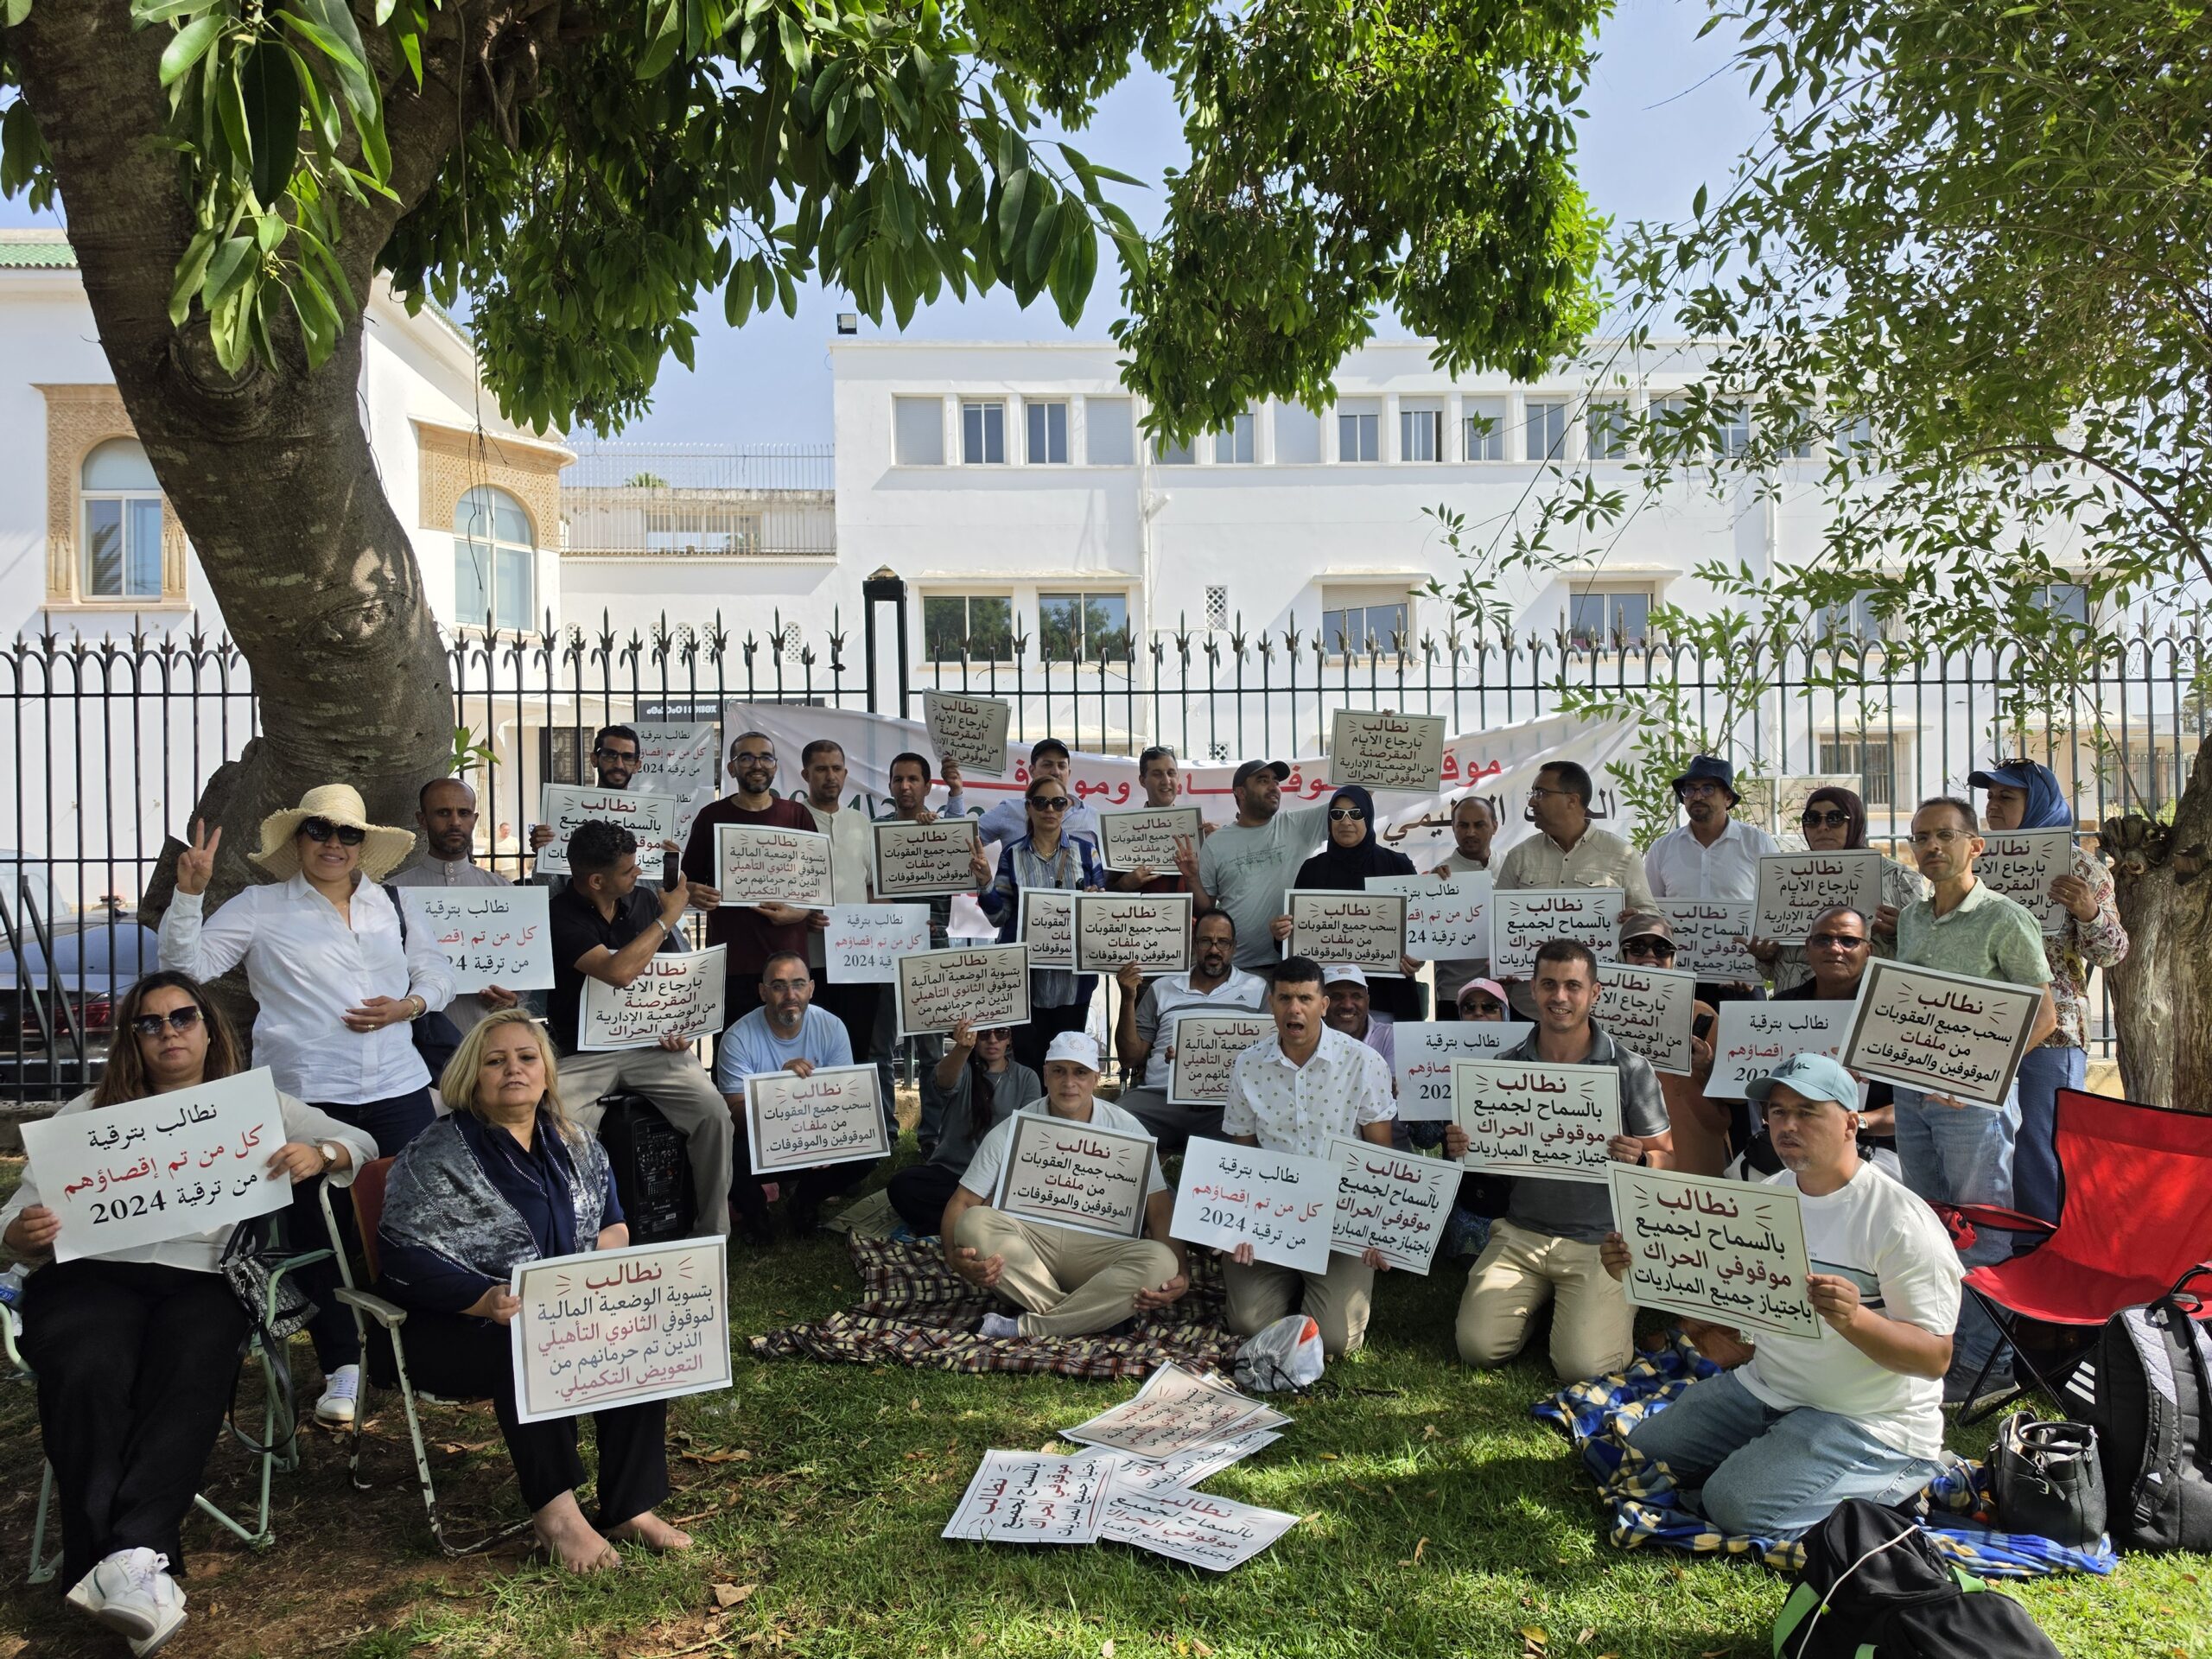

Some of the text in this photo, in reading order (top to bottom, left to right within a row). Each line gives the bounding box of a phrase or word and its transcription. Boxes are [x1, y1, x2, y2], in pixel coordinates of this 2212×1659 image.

[1362, 718, 1409, 734] نطالب
[1347, 769, 1426, 785] لموقوفي الحراك
[1375, 760, 1420, 774] الوضعية
[1421, 765, 1434, 774] من
[1790, 860, 1844, 880] نطالب
[425, 899, 509, 920] نطالب بترقية
[1111, 906, 1157, 922] نطالب
[1526, 897, 1583, 917] نطالب
[1084, 923, 1181, 938] بسحب جميع العقوبات
[1507, 916, 1611, 934] بالسماح لجميع
[471, 925, 537, 949] كل من تم
[1108, 937, 1158, 950] من ملفات
[474, 955, 529, 975] من ترقية
[939, 954, 988, 972] نطالب
[1141, 950, 1181, 963] الموقوفين
[911, 968, 1020, 987] بتسوية الوضعية المالية
[987, 979, 1021, 995] لموقوفي
[646, 1004, 700, 1023] الوضعية
[702, 1002, 716, 1014] من
[918, 992, 1013, 1016] الذين تم حرمانهم من
[971, 1004, 1013, 1021] التعويض
[1917, 991, 1983, 1015] نطالب
[608, 1014, 707, 1037] لموقوفي الحراك
[1749, 1014, 1829, 1035] نطالب بترقية
[1874, 1004, 2012, 1047] بسحب جميع العقوبات
[1426, 1033, 1500, 1052] نطالب بترقية
[1900, 1031, 1971, 1058] من ملفات
[1939, 1061, 2001, 1083] الموقوفين
[791, 1082, 842, 1103] نطالب
[1496, 1072, 1567, 1096] نطالب
[764, 1102, 872, 1122] بسحب جميع العقوبات
[1473, 1097, 1603, 1122] بالسماح لجميع
[87, 1104, 217, 1151] نطالب بترقية
[791, 1119, 847, 1134] من ملفات
[830, 1128, 876, 1147] الموقوفين
[1477, 1119, 1605, 1147] موقوفي الحراك
[235, 1123, 264, 1159] كل
[1056, 1139, 1111, 1160] نطالب
[199, 1146, 225, 1168] من
[1466, 1141, 1572, 1164] جميع المباريات
[168, 1151, 188, 1179] تم
[1020, 1152, 1138, 1187] بسحب جميع العقوبات
[1218, 1157, 1300, 1185] نطالب بترقية
[1365, 1160, 1422, 1184] نطالب
[1045, 1174, 1105, 1197] من ملفات
[1338, 1176, 1440, 1214] بالسماح لجميع
[90, 1173, 257, 1224] من ترقية 2024
[1081, 1199, 1132, 1218] الموقوفين
[1255, 1198, 1271, 1214] تم
[1656, 1187, 1739, 1218] نطالب
[1274, 1204, 1294, 1217] من
[1298, 1202, 1324, 1223] كل
[1336, 1197, 1431, 1234] موقوفي الحراك
[1199, 1206, 1306, 1250] من ترقية 2024
[1636, 1217, 1785, 1261] بالسماح لجميع
[1368, 1231, 1431, 1258] باجتياز جميع
[1643, 1241, 1792, 1291] موقوفي الحراك
[585, 1261, 662, 1295] نطالب
[537, 1285, 712, 1320] بتسوية الوضعية المالية
[1634, 1268, 1812, 1324] باجتياز جميع المباريات
[605, 1313, 658, 1346] الثانوي
[662, 1305, 715, 1337] لموقوفي
[550, 1331, 702, 1376] الذين تم حرمانهم من
[635, 1353, 703, 1385] التعويض
